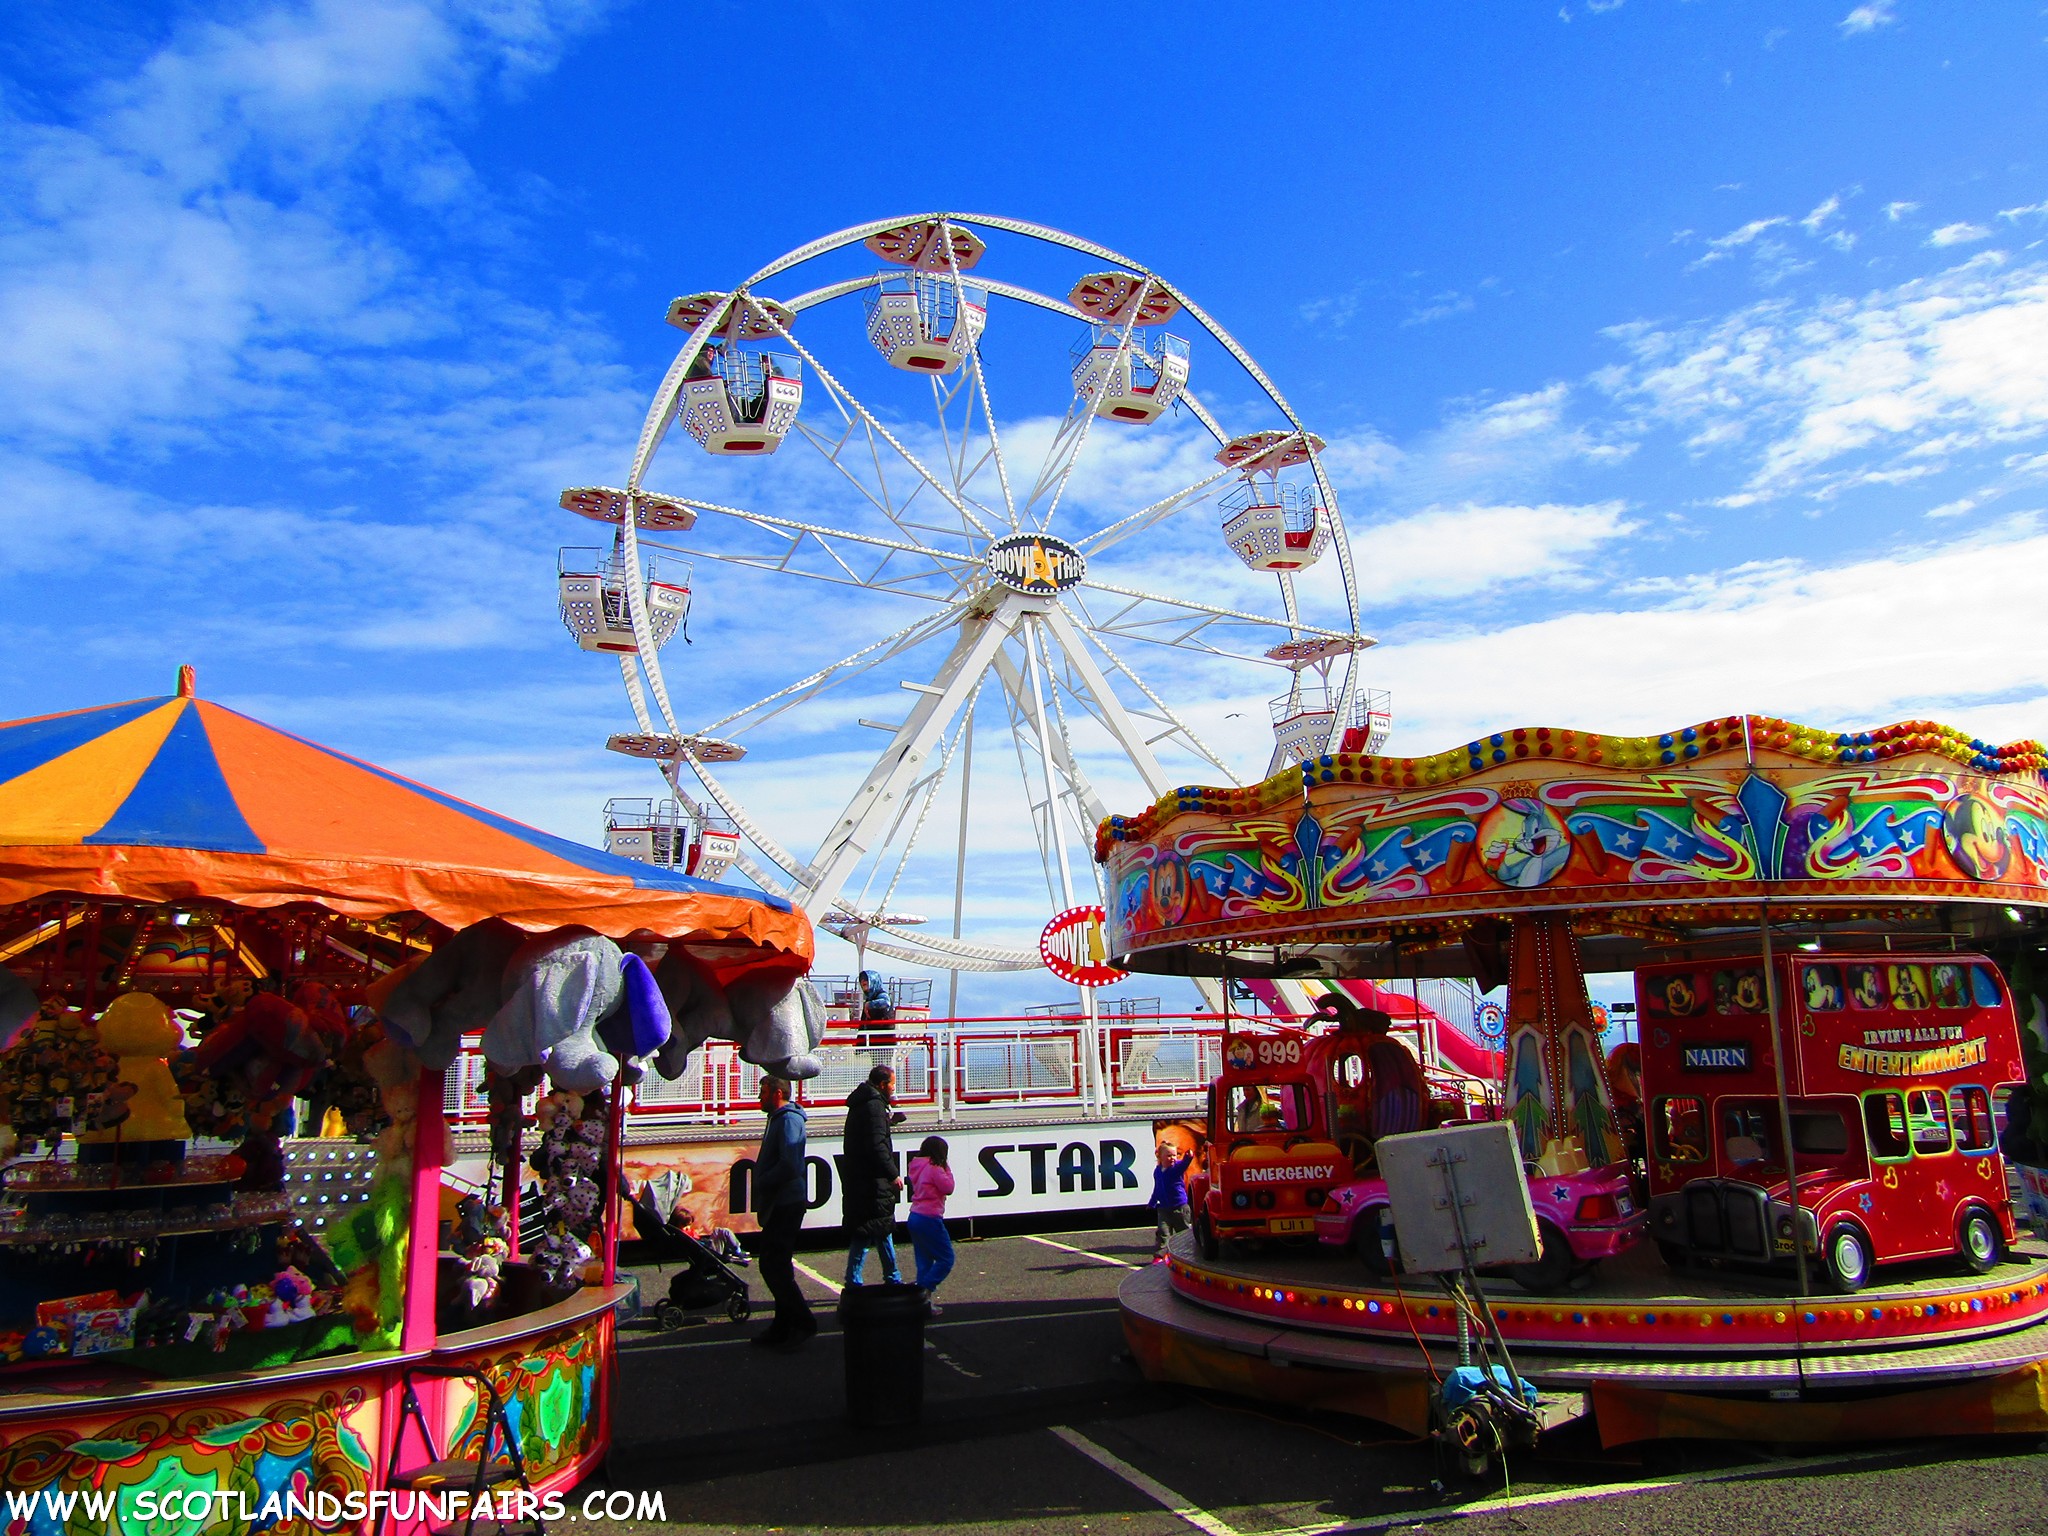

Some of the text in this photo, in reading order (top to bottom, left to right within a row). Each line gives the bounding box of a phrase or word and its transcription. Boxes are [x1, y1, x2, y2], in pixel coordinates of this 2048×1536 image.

[992, 545, 1083, 580] MOVIE STAR
[1048, 921, 1095, 968] MOVIE
[1863, 1026, 1963, 1045] IRVIN'S ALL FUN
[1258, 1040, 1301, 1064] 999
[1685, 1048, 1747, 1067] NAIRN
[1838, 1036, 1988, 1077] ENTERTAINMENT
[977, 1139, 1139, 1198] STAR
[1242, 1165, 1334, 1182] EMERGENCY
